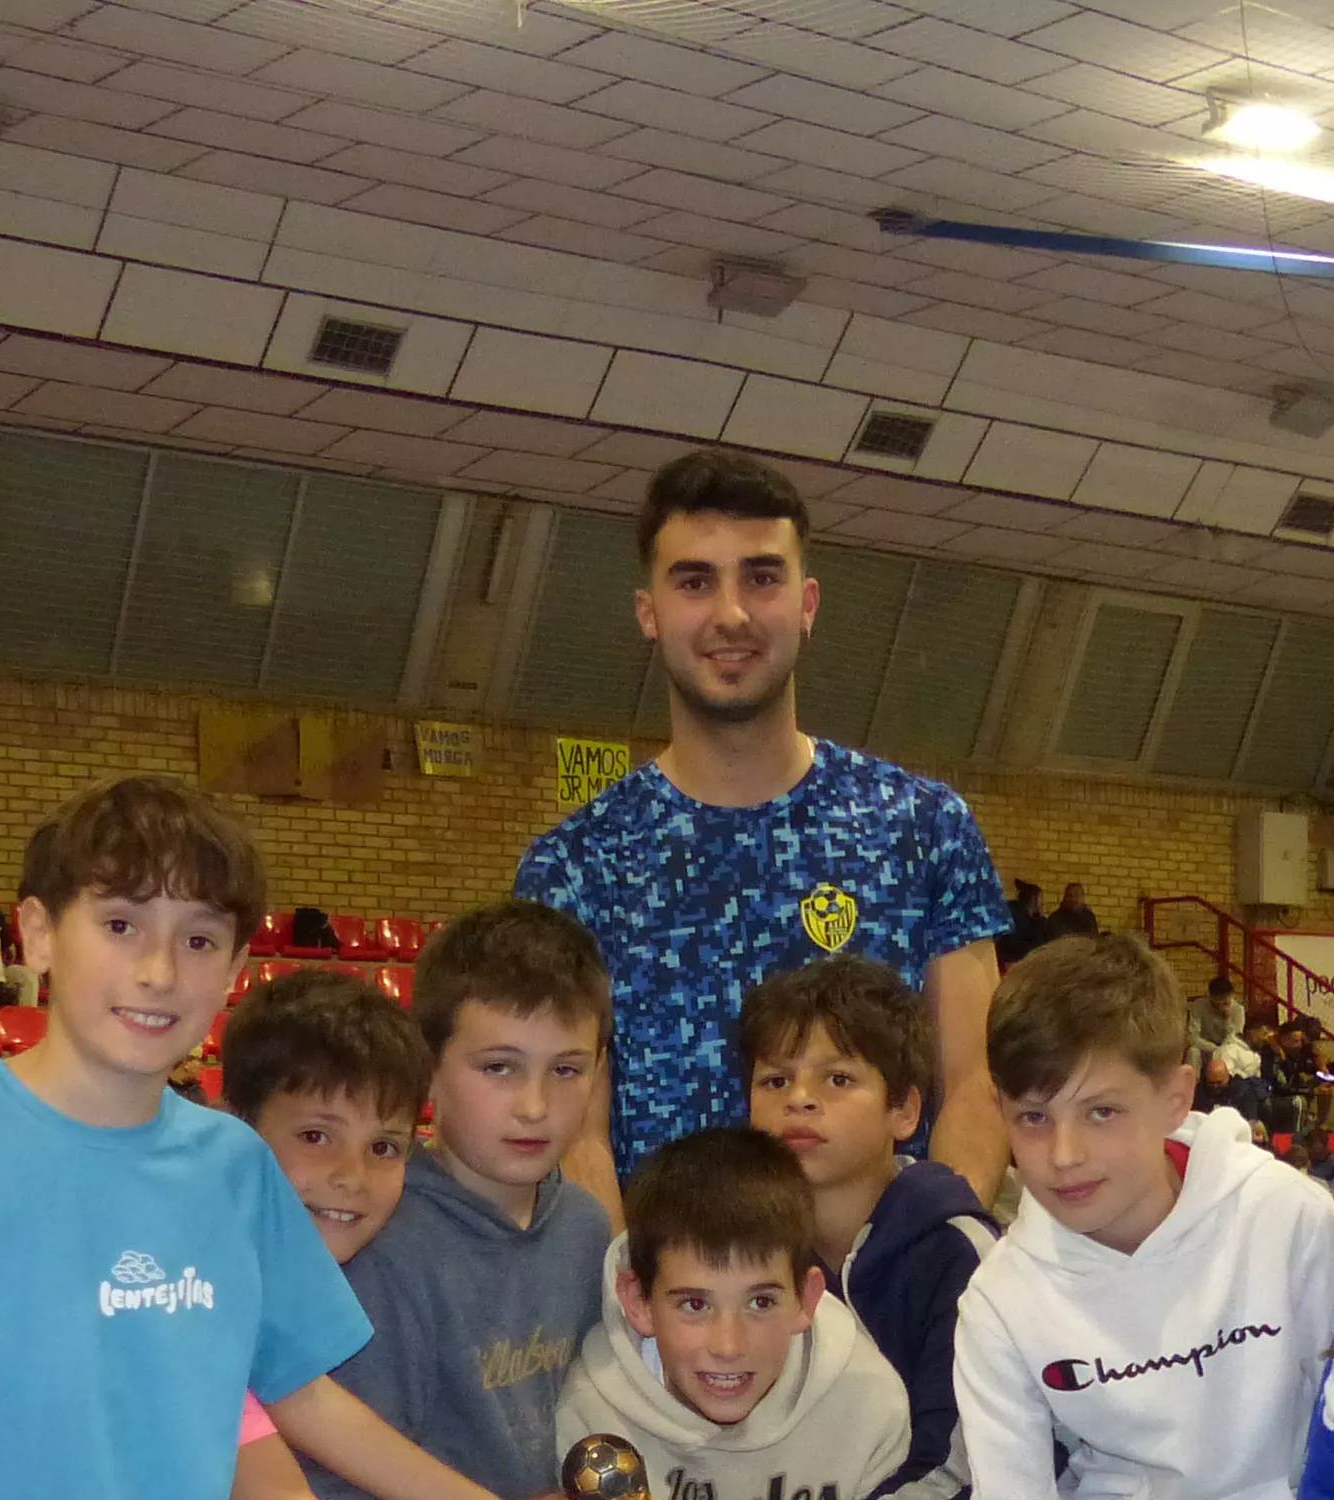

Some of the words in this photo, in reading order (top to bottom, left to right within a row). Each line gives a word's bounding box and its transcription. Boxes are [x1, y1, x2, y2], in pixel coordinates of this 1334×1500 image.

[559, 742, 627, 779] VAMOS
[560, 775, 586, 804] JR
[1041, 1324, 1282, 1392] Champion
